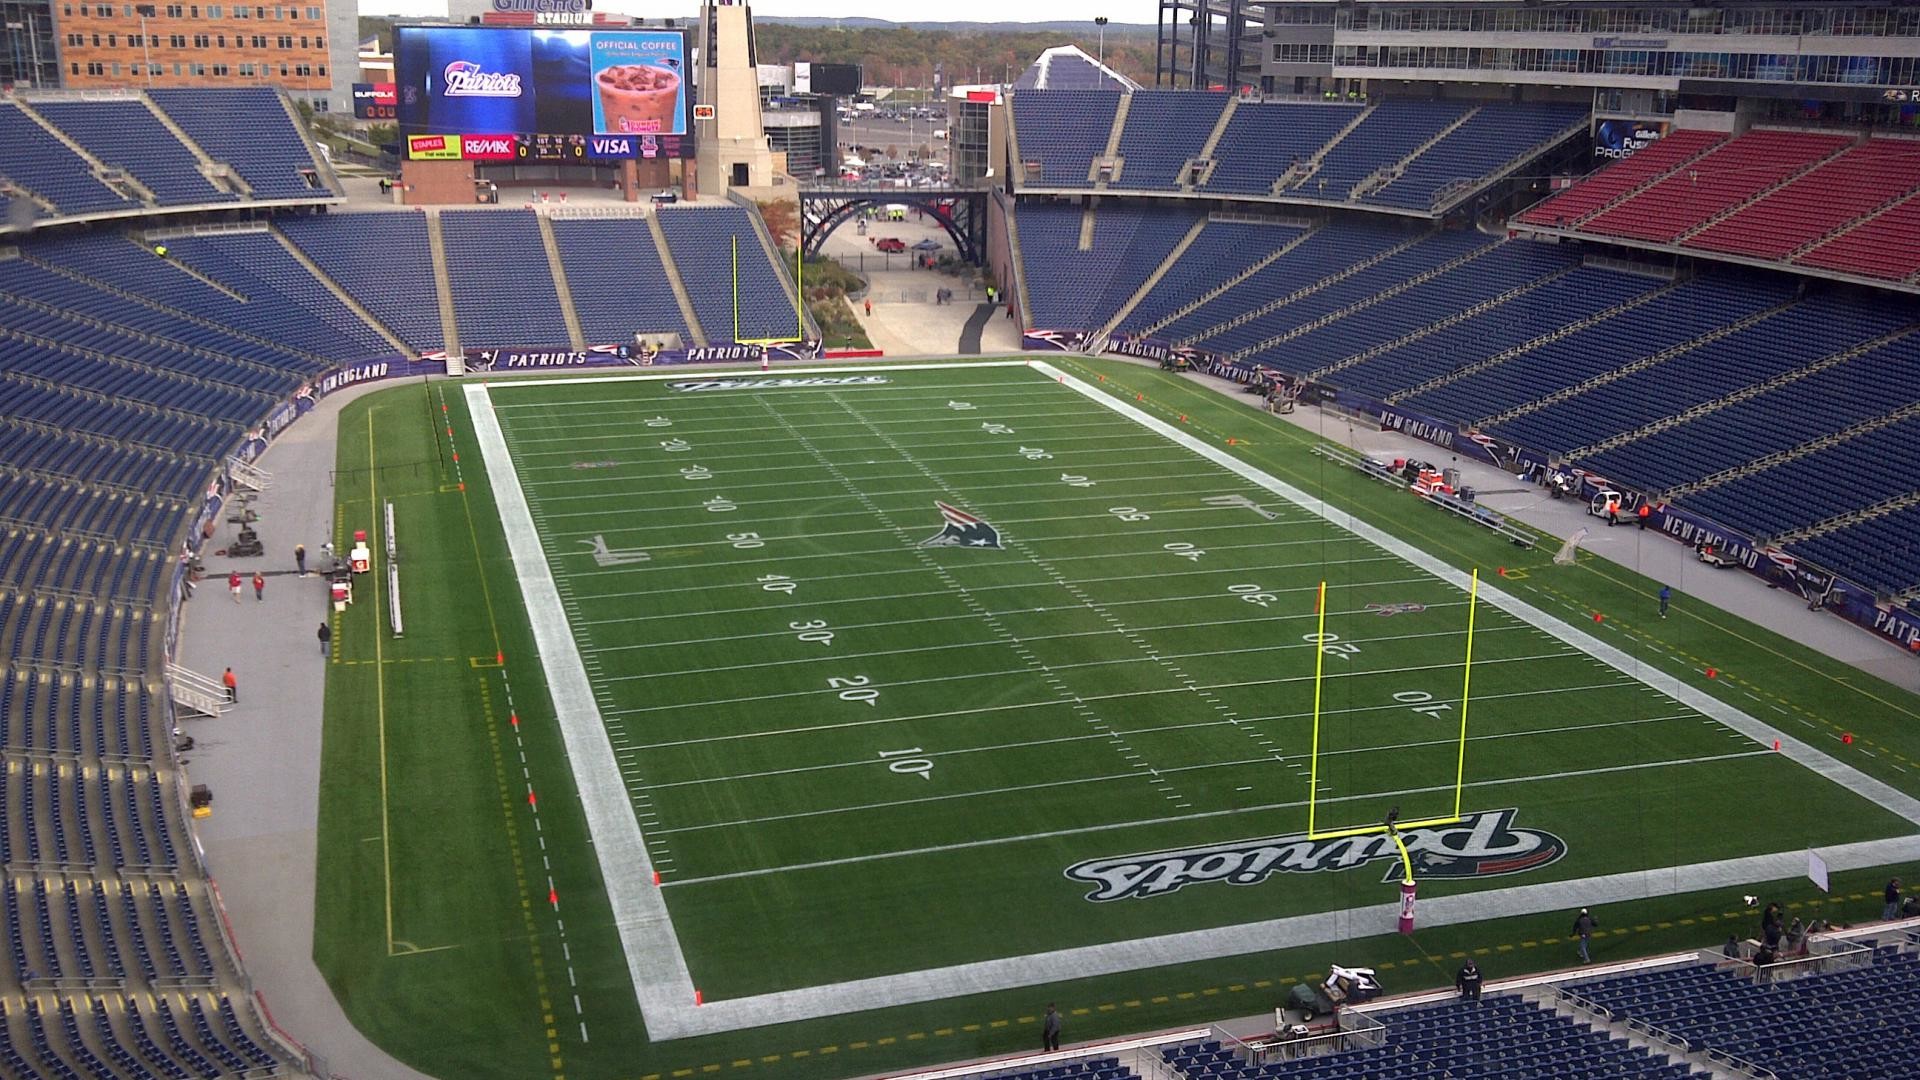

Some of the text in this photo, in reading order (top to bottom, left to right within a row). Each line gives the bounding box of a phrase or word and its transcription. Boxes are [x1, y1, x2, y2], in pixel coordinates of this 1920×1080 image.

[536, 12, 593, 24] STADIUM
[596, 41, 677, 51] OFFICIAL COFFEE
[444, 61, 522, 97] Patriots
[411, 138, 444, 151] STAPLES
[464, 140, 510, 154] RE/MAX
[519, 146, 527, 157] 0
[574, 146, 582, 157] 0
[593, 140, 630, 153] VISA
[508, 351, 586, 367] PATRIOTS
[687, 345, 761, 361] PATRIOTS
[1121, 341, 1167, 361] ENGLAND
[338, 362, 388, 386] ENGLAND
[1380, 410, 1453, 446] NEW ENGLAND
[679, 464, 713, 480] 30
[702, 495, 737, 512] 40
[1109, 506, 1151, 522] 50
[1663, 514, 1695, 539] NEW
[726, 532, 765, 549] 50
[1163, 542, 1206, 562] 40
[757, 574, 797, 595] 40
[1227, 584, 1278, 608] 30
[789, 619, 834, 646] 30
[1302, 632, 1361, 661] 20
[827, 675, 880, 706] 20
[1392, 691, 1452, 719] 10
[878, 747, 933, 780] 10
[1063, 807, 1569, 903] Patriots
